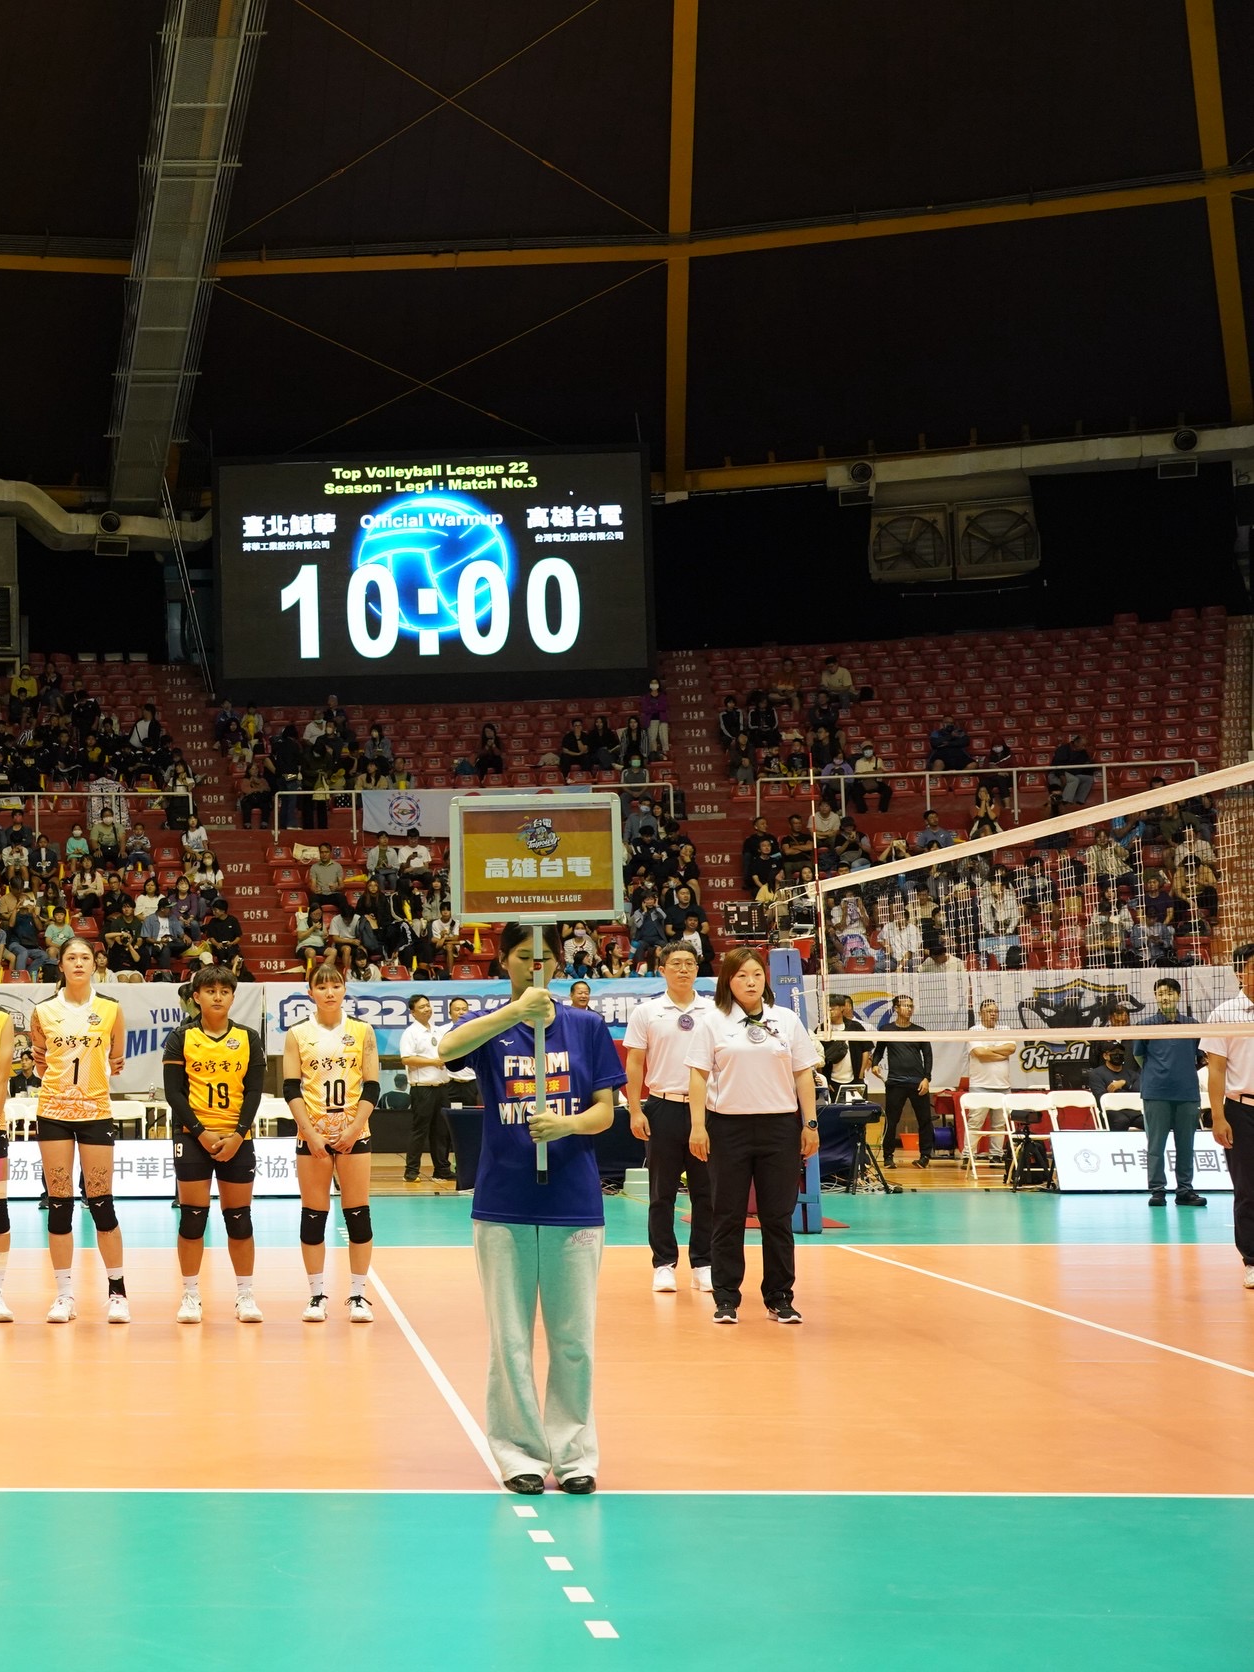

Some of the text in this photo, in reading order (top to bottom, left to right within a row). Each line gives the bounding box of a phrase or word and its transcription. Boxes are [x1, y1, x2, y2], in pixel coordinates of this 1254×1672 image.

[332, 462, 529, 481] Top Volleyball League 22
[324, 482, 382, 495] Season
[395, 480, 434, 494] Leg1
[448, 478, 498, 491] Match
[501, 476, 538, 489] No.3
[360, 511, 504, 529] Official Warmup
[526, 504, 623, 529] 高雄台電
[534, 531, 624, 543] 台灣電力股份有限公司
[280, 557, 581, 659] 10:00
[484, 856, 592, 879] 高雄台電
[496, 894, 582, 904] TOP VOLLEYBALL LEAGUE
[53, 1034, 103, 1048] 台灣電力
[72, 1057, 80, 1085] 1
[192, 1059, 242, 1073] 台灣電力
[504, 1051, 570, 1077] FRM
[205, 1081, 230, 1110] 19
[323, 1079, 346, 1108] 10
